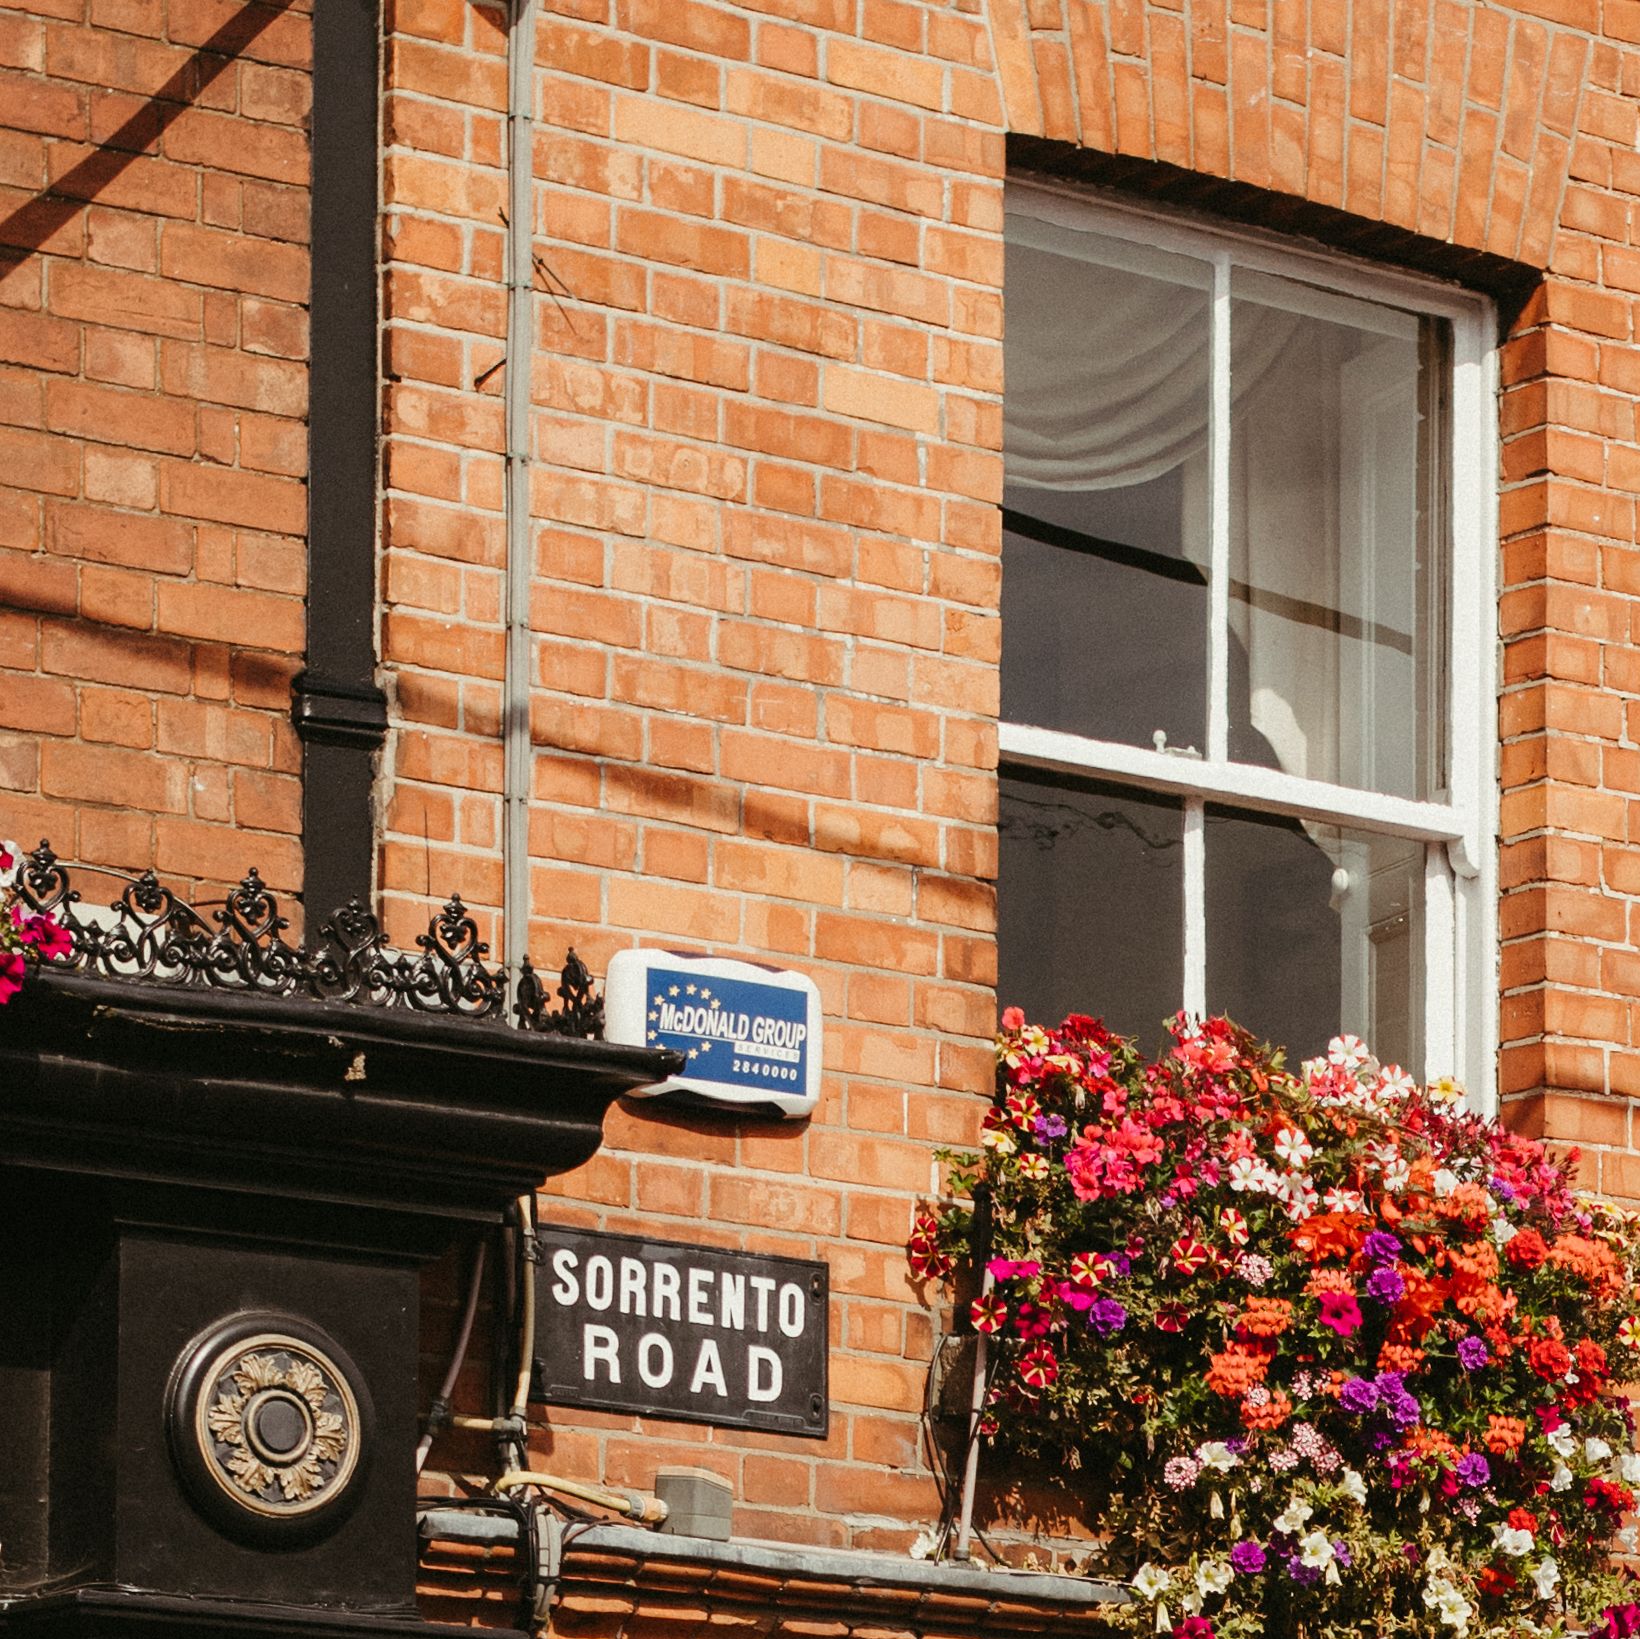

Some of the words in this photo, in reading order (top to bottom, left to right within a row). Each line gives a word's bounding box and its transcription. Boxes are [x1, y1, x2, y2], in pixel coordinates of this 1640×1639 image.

[660, 1002, 750, 1041] McDONALD
[752, 1016, 807, 1050] GROUP
[733, 1060, 798, 1081] 2840000
[737, 1043, 798, 1061] SERVICES
[552, 1249, 806, 1338] SORRENTO
[583, 1323, 783, 1402] ROAD
